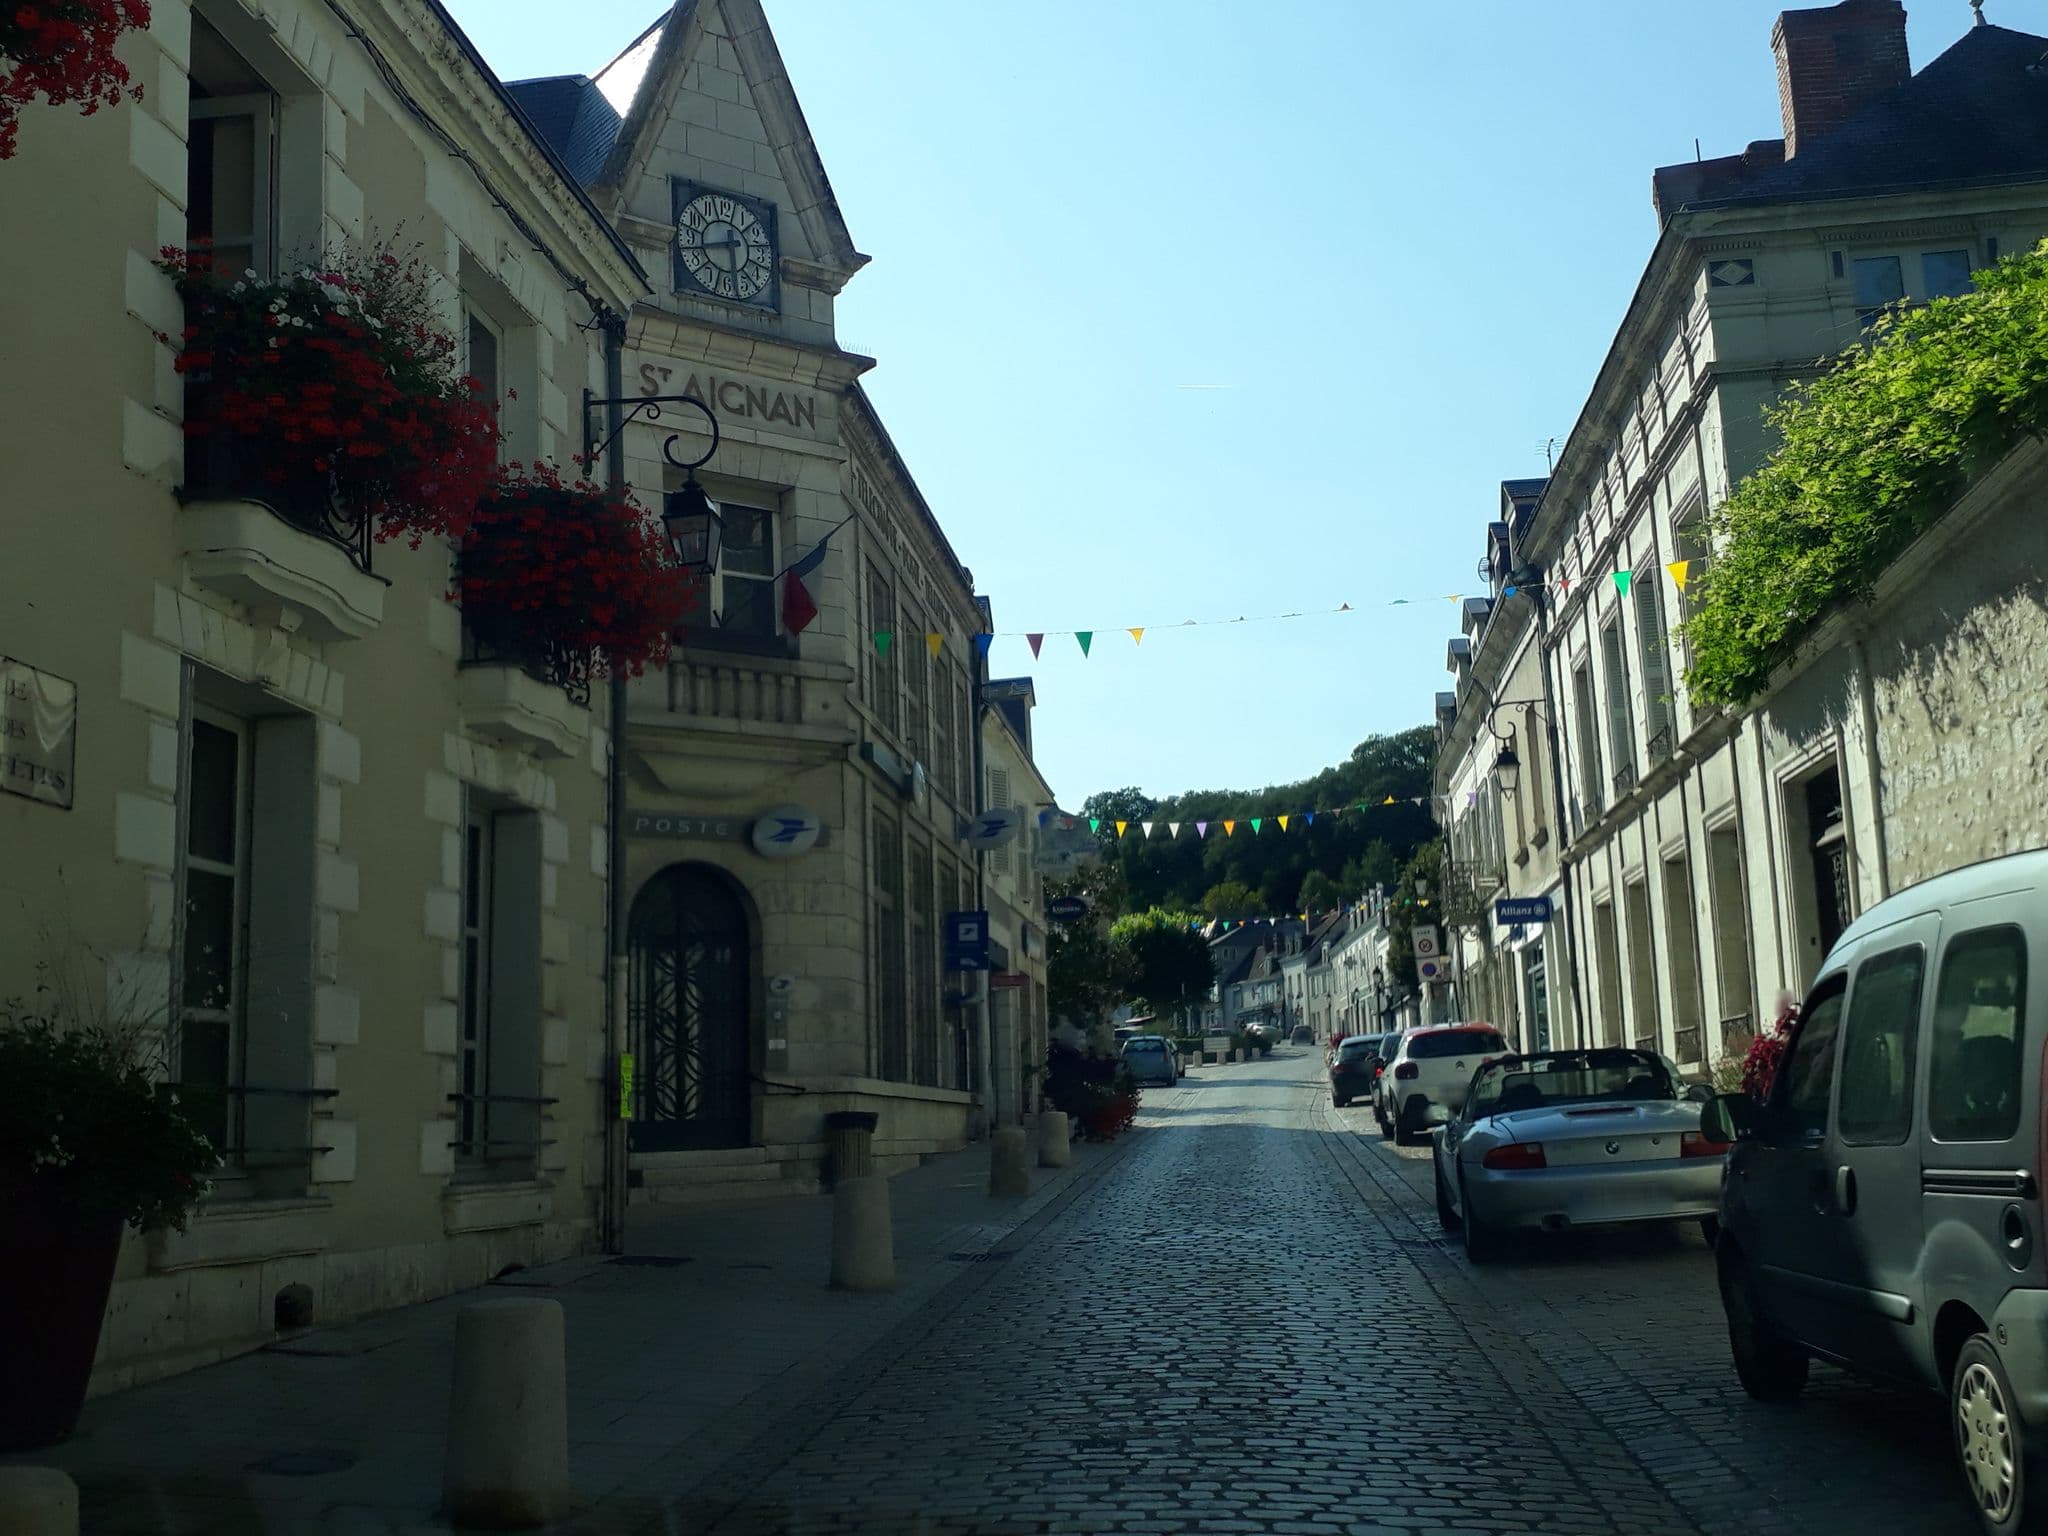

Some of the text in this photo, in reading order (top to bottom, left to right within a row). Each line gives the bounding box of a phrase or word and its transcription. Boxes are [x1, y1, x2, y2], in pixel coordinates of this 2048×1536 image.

[704, 200, 712, 217] 11
[720, 200, 731, 218] 12
[689, 210, 701, 229] 10
[686, 229, 695, 246] 9
[752, 227, 760, 244] 2
[691, 249, 700, 267] 8
[756, 247, 765, 264] 3
[704, 266, 713, 284] 7
[751, 265, 760, 281] 4
[723, 275, 732, 293] 6
[740, 274, 749, 293] 5
[682, 373, 817, 431] AIGNAN
[634, 817, 729, 837] POSTE
[1500, 906, 1532, 916] Allianz
